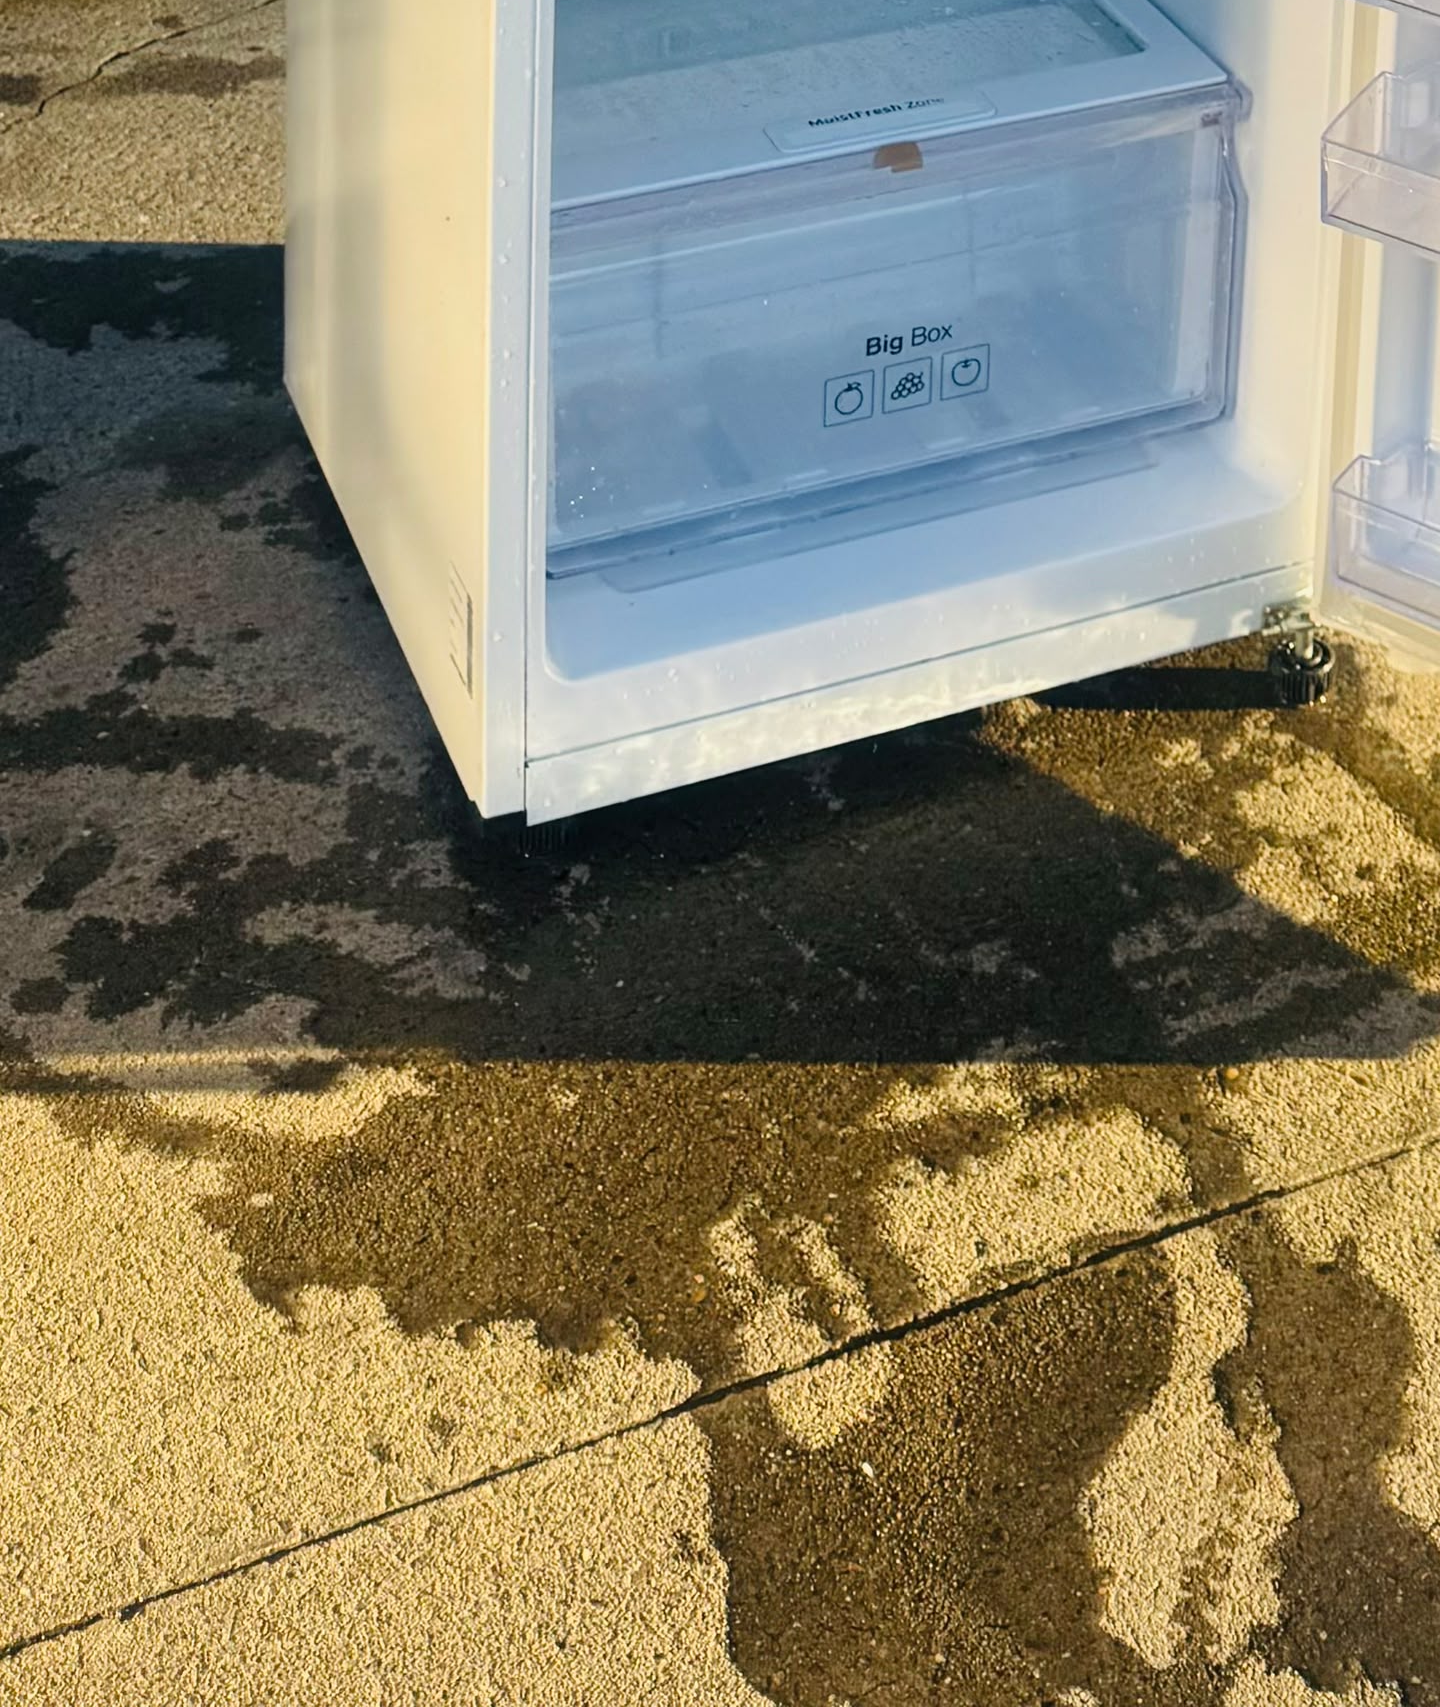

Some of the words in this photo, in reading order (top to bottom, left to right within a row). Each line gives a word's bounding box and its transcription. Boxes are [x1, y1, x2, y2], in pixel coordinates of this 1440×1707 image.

[905, 97, 945, 109] Zone
[865, 333, 903, 356] Big
[911, 324, 953, 347] Box
